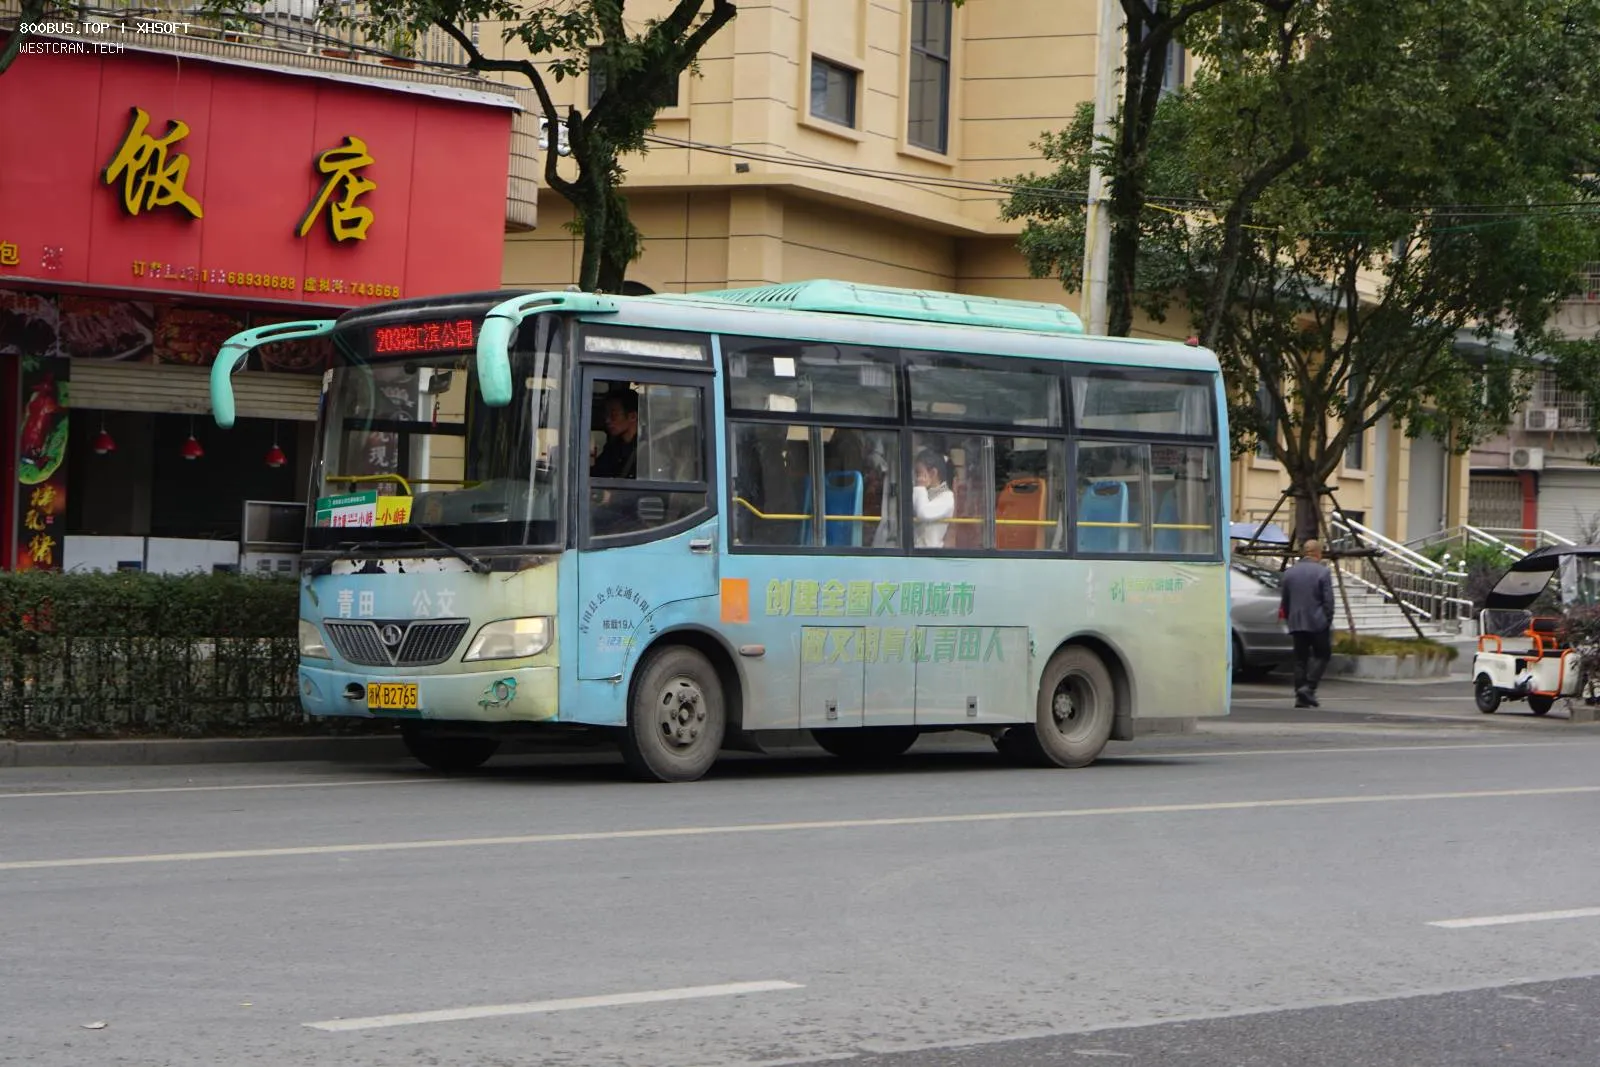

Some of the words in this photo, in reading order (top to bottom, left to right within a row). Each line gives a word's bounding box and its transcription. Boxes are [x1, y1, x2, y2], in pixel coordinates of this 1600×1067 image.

[25, 485, 56, 565] 烤乳猪
[337, 588, 374, 618] 青田
[412, 587, 456, 618] 公交
[764, 577, 976, 617] 创建全国文明城市
